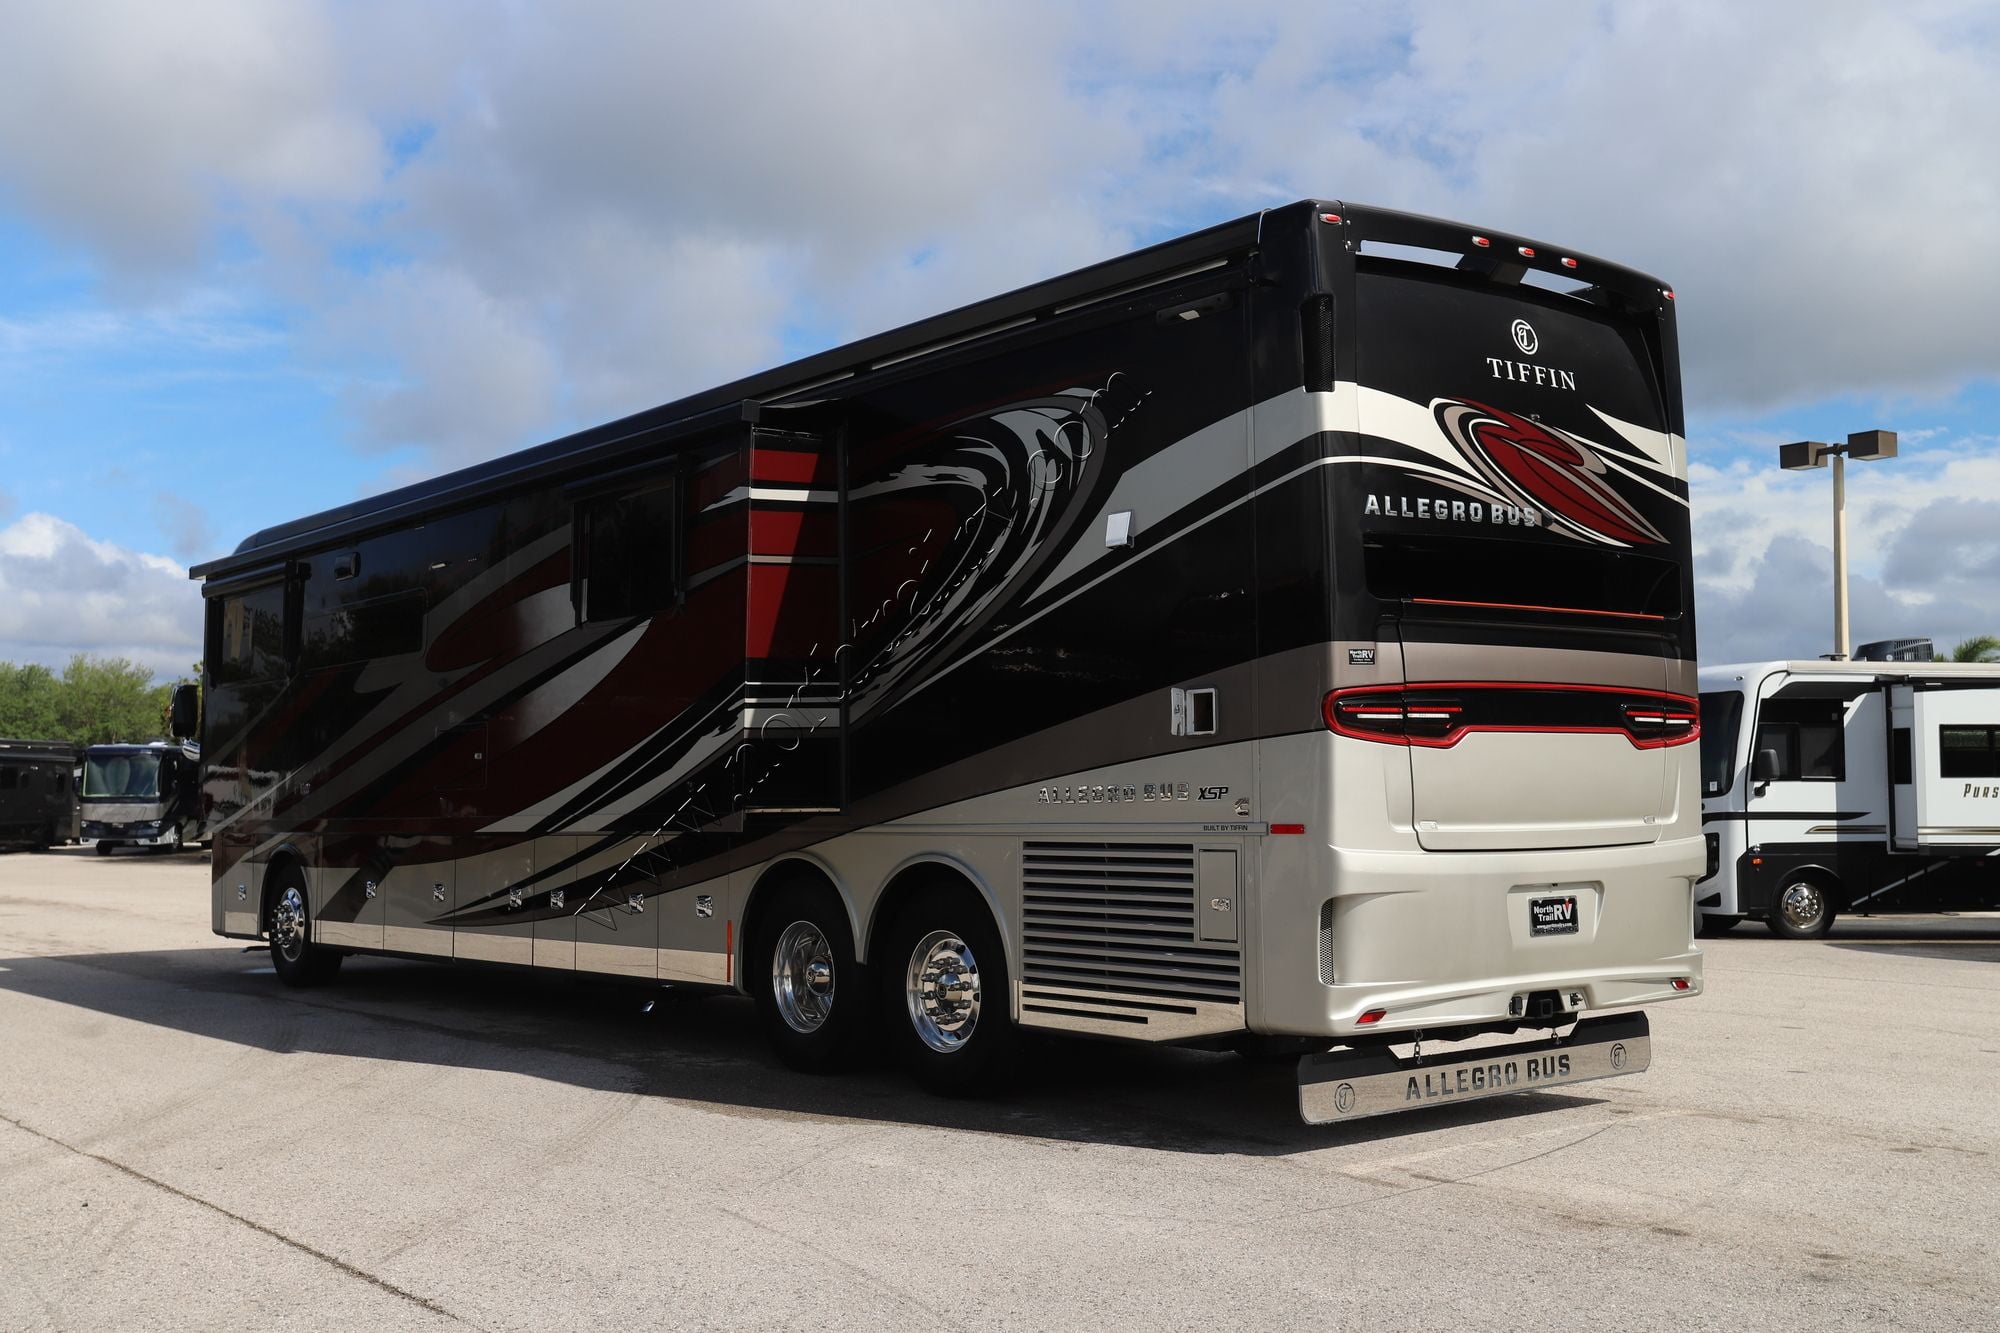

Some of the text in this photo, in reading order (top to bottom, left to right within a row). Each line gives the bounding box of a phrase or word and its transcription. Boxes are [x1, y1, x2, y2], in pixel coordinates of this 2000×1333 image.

[1486, 357, 1576, 391] TIFFIN
[1364, 494, 1536, 528] ALLEGRO BUS
[1038, 782, 1229, 804] ALLEGRO BUS XSP
[1533, 905, 1553, 914] North
[1538, 913, 1554, 922] Trail
[1553, 903, 1573, 921] RV
[1406, 1054, 1571, 1101] ALLEGRO BUS
